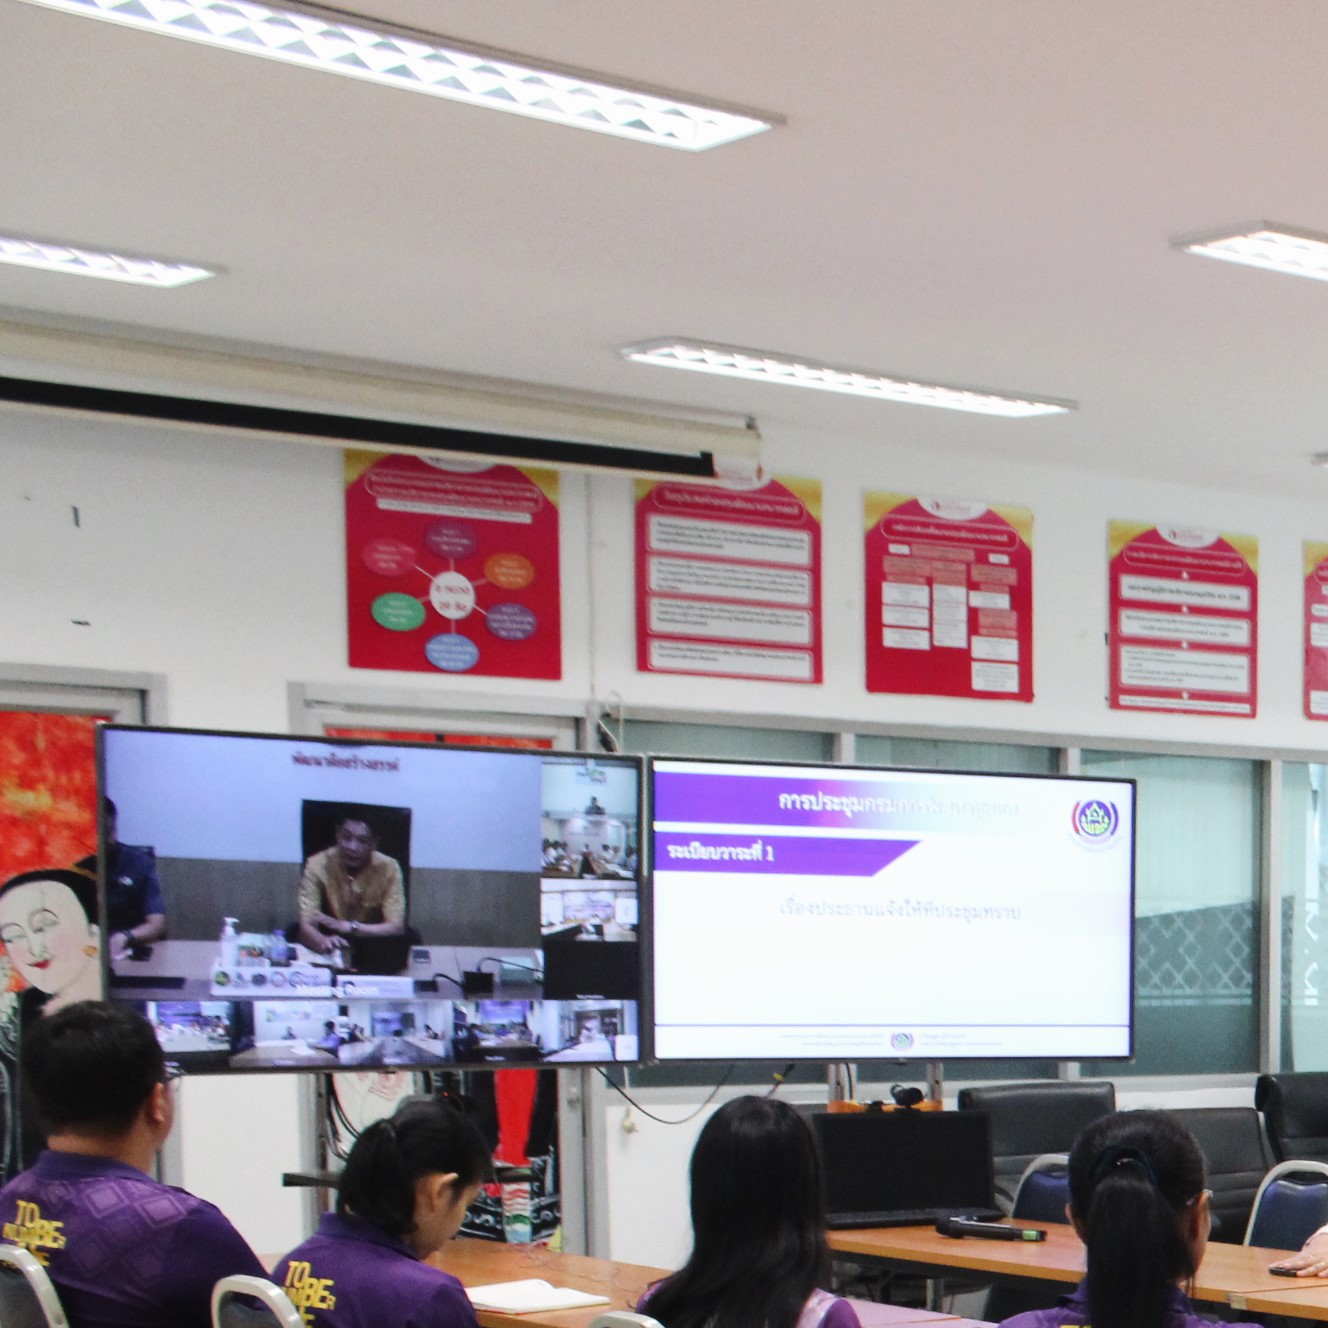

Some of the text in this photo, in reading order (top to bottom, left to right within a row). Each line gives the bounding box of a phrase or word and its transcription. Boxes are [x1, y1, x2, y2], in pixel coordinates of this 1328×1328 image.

[666, 839, 775, 862] ระเบียบวาระที่ 1
[15, 1199, 41, 1228] TO
[285, 1260, 311, 1288] TO
